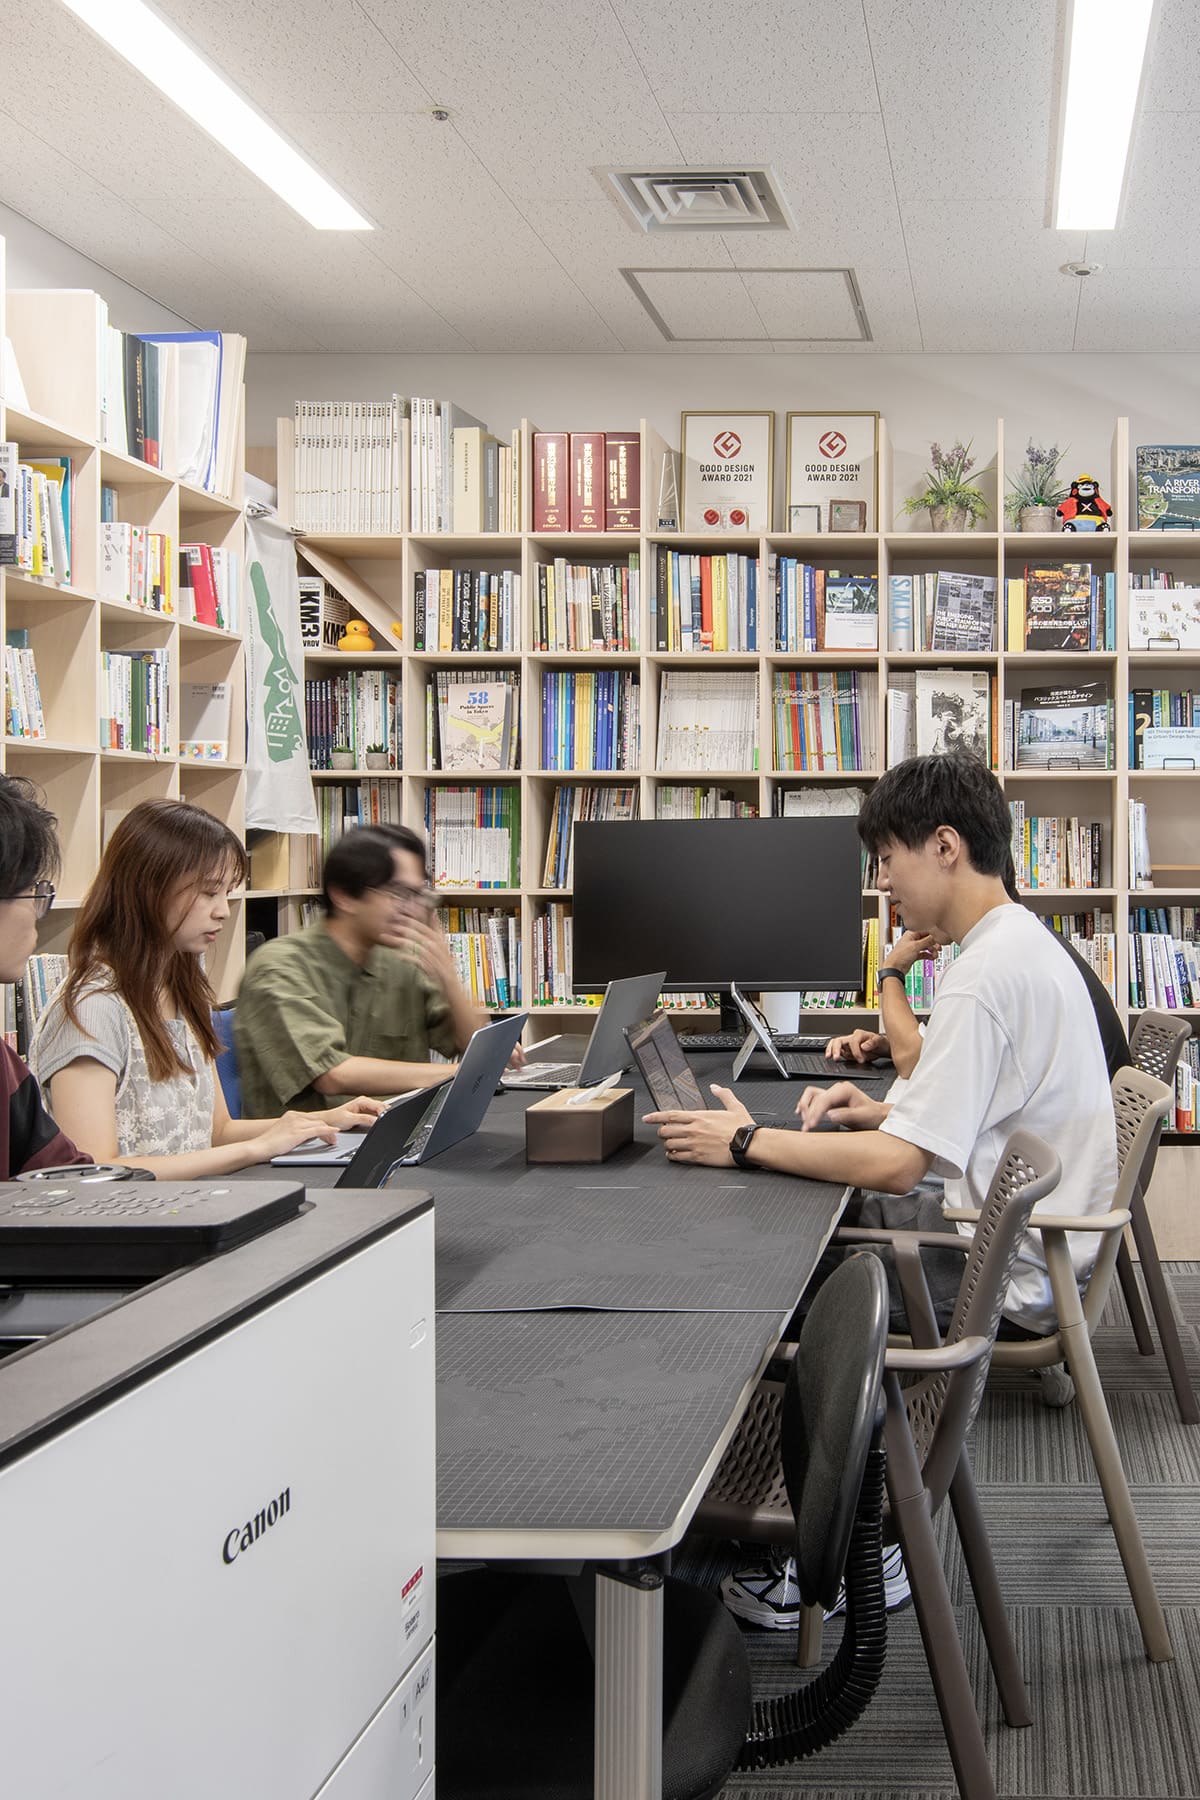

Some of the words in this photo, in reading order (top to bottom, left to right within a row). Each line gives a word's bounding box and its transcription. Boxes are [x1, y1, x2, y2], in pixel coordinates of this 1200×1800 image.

[699, 464, 722, 472] GOOD
[724, 464, 755, 472] DESIGN
[805, 464, 828, 472] GOOD
[829, 464, 861, 472] DESIGN
[701, 473, 731, 482] AWARD
[734, 473, 753, 482] 2021
[807, 473, 837, 482] AWARD
[839, 473, 859, 482] 2021
[1164, 479, 1172, 487] A
[1173, 479, 1200, 487] RIVER
[299, 591, 320, 637] KM3
[467, 691, 489, 705] 58
[222, 1486, 291, 1564] Canon
